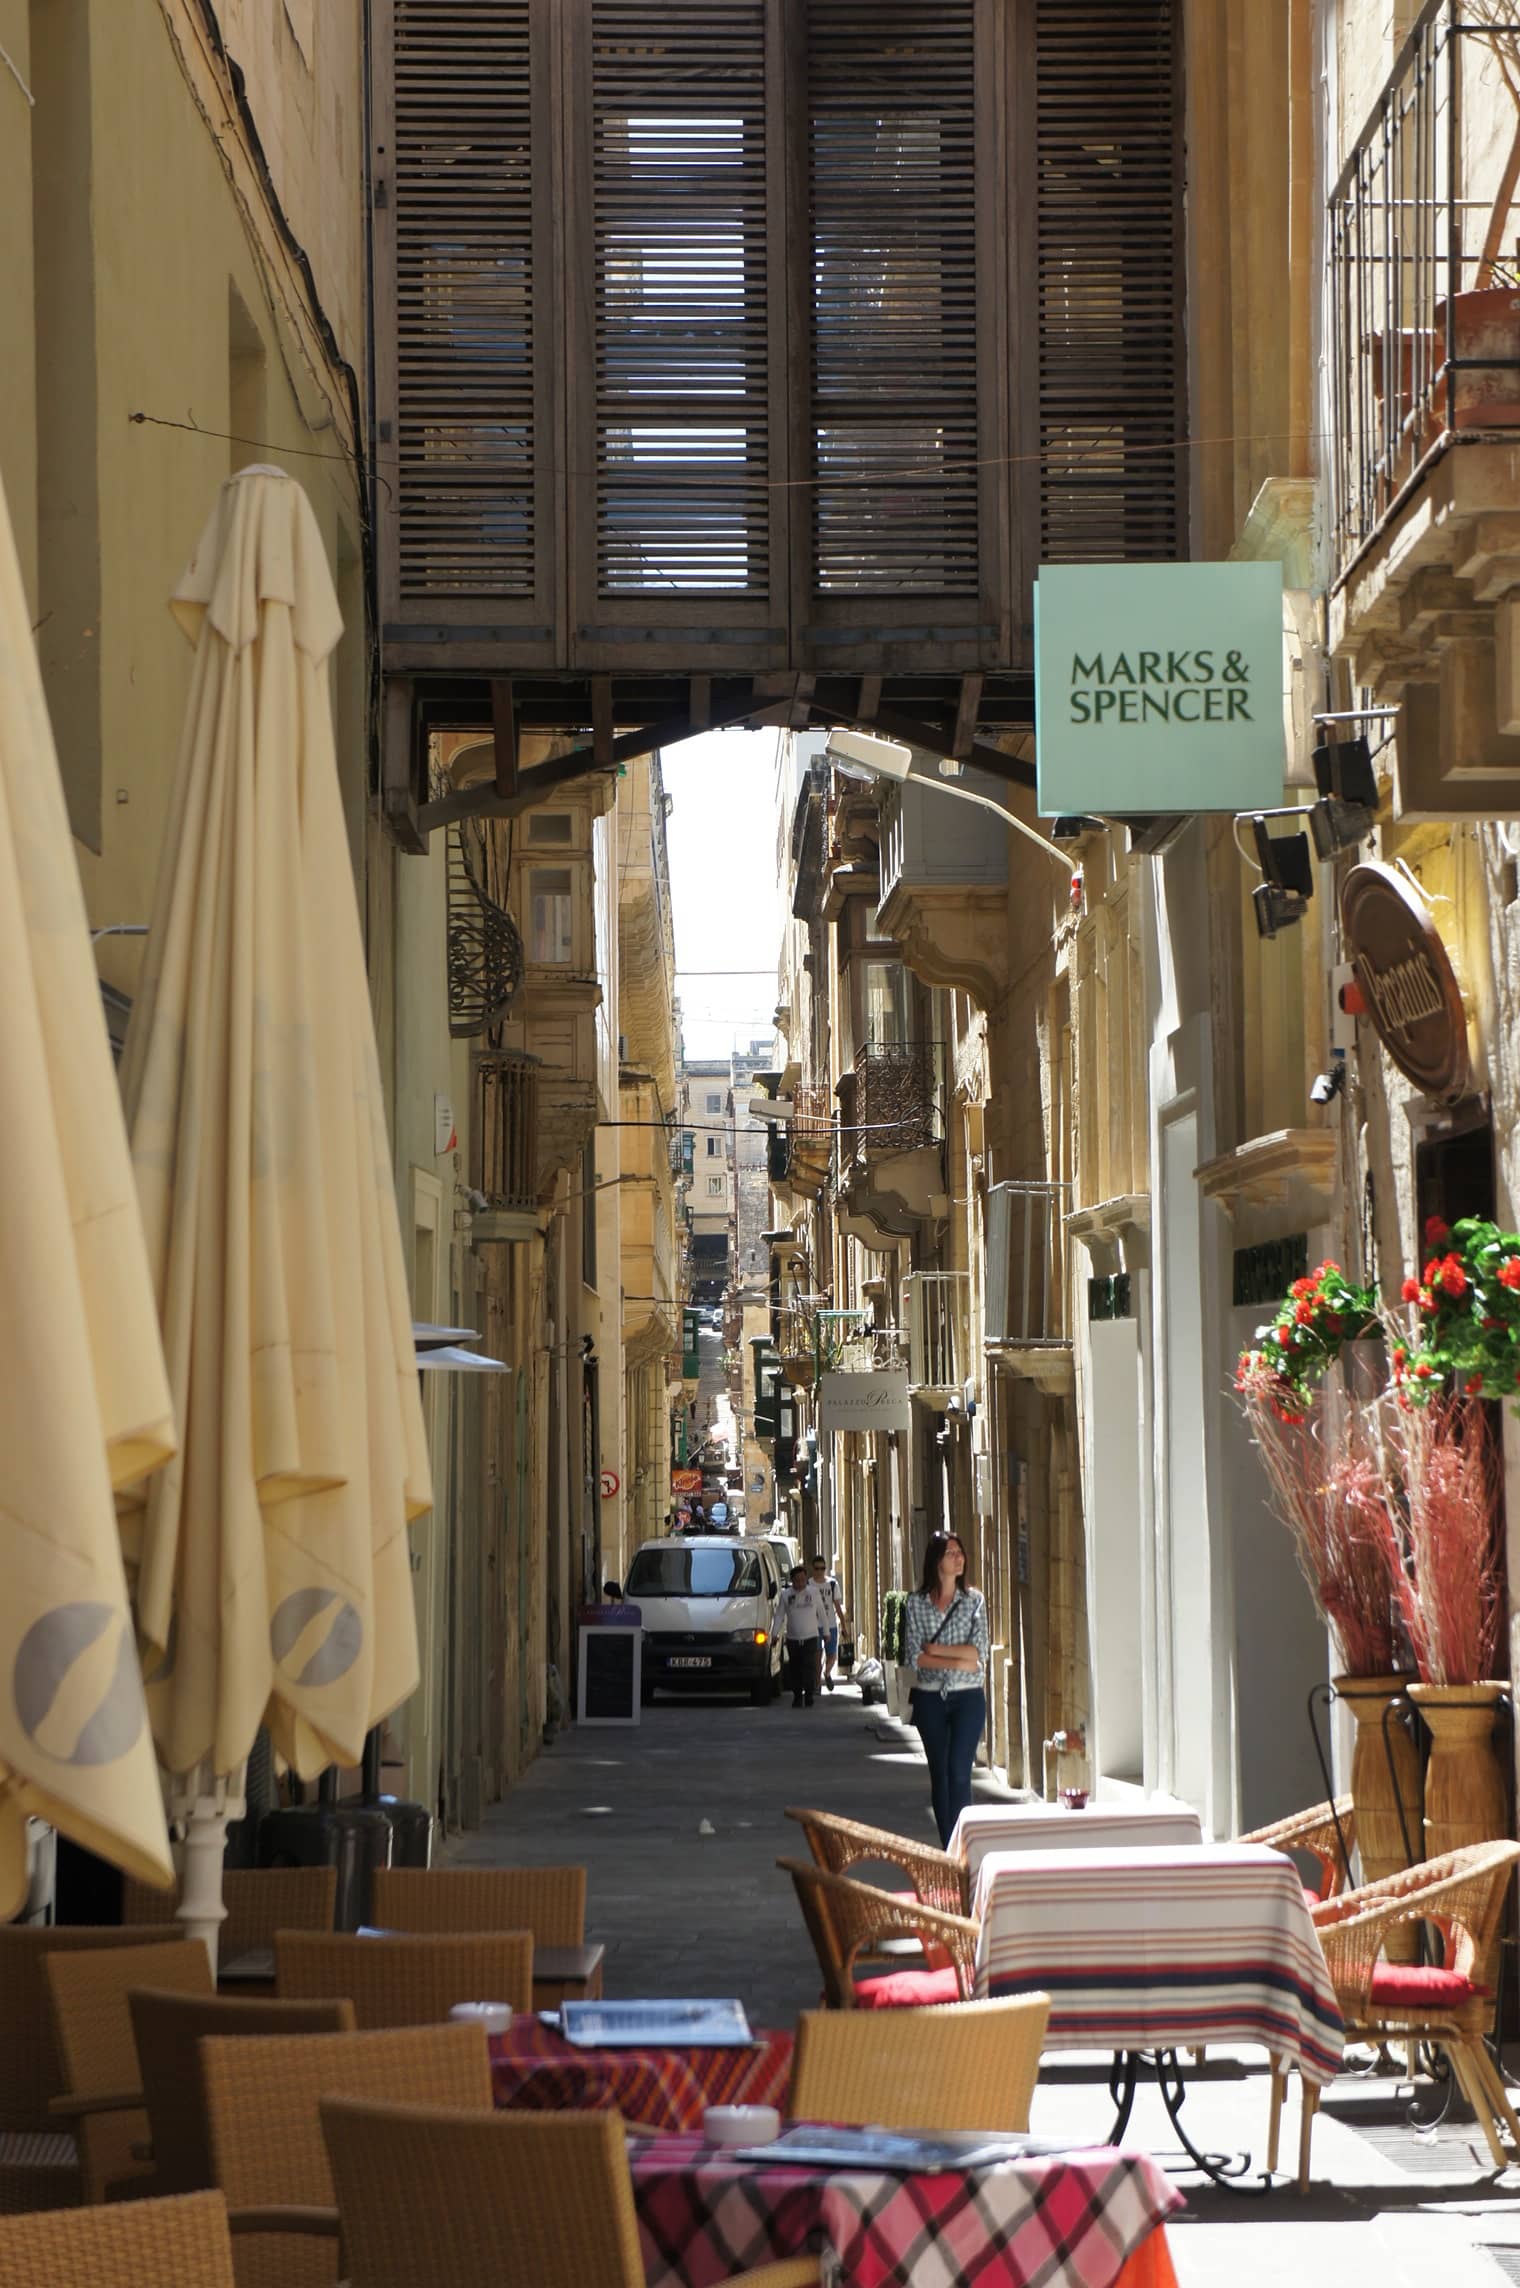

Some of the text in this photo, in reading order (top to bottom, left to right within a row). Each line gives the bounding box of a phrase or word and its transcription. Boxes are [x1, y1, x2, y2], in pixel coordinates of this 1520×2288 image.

[1071, 650, 1250, 685] MARKS &
[1070, 688, 1255, 724] SPENCER
